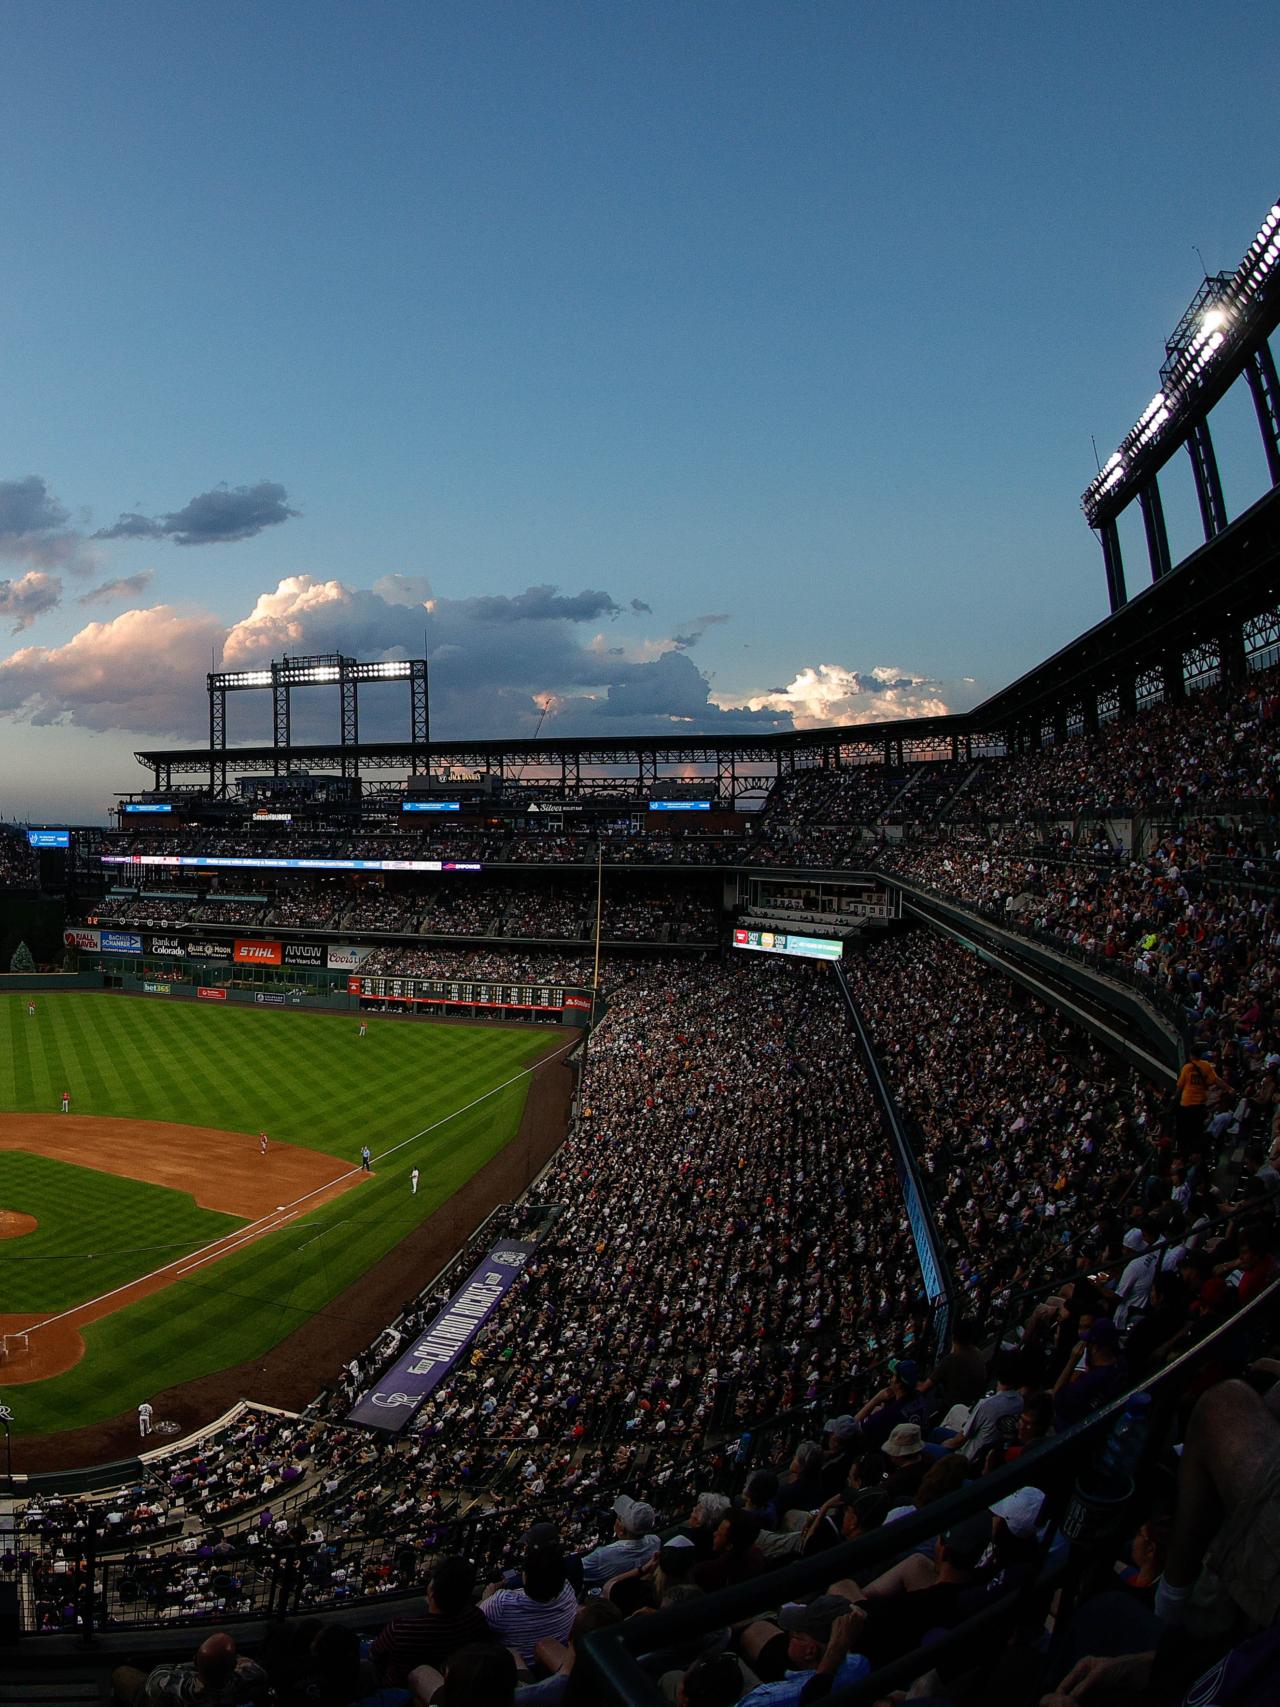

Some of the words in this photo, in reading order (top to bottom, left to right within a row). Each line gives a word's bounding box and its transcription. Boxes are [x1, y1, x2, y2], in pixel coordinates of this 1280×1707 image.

[448, 772, 461, 781] JACK
[540, 803, 562, 811] Silver
[152, 938, 170, 946] Bank
[170, 938, 178, 947] of
[152, 946, 185, 956] Colorado
[214, 945, 231, 953] MOON
[240, 947, 275, 958] STIHL
[328, 952, 353, 964] Coors
[144, 983, 169, 993] bet365
[413, 1314, 478, 1362] COLORADO
[450, 1282, 504, 1318] ROCKIES
